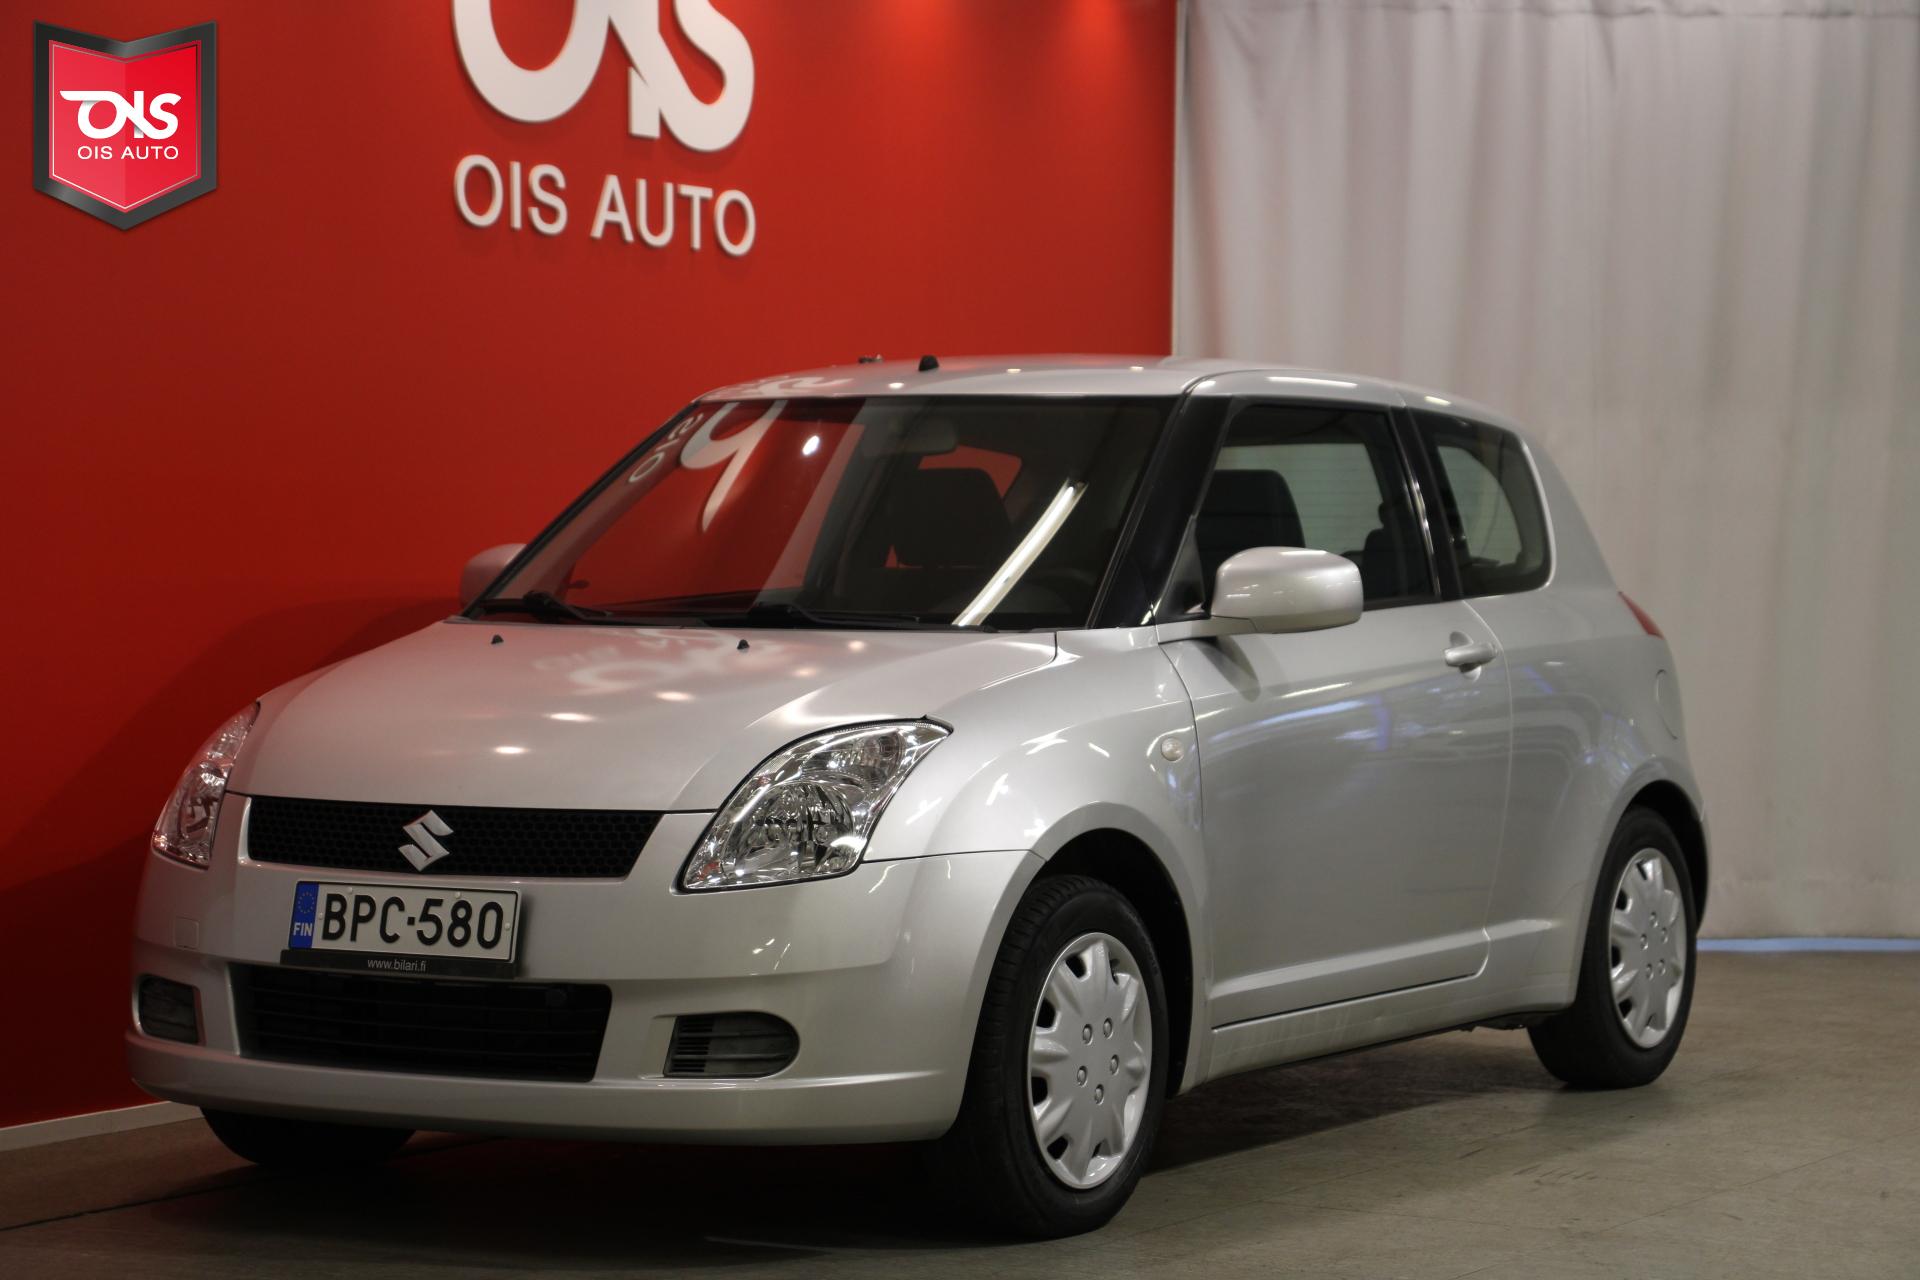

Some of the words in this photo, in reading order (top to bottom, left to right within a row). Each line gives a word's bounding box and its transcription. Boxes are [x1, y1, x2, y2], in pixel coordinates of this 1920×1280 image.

[454, 154, 568, 235] OIS
[590, 174, 757, 256] AUTO
[292, 921, 313, 937] FIN
[321, 893, 504, 949] BPC-580
[367, 958, 427, 972] www.bilari.fi
